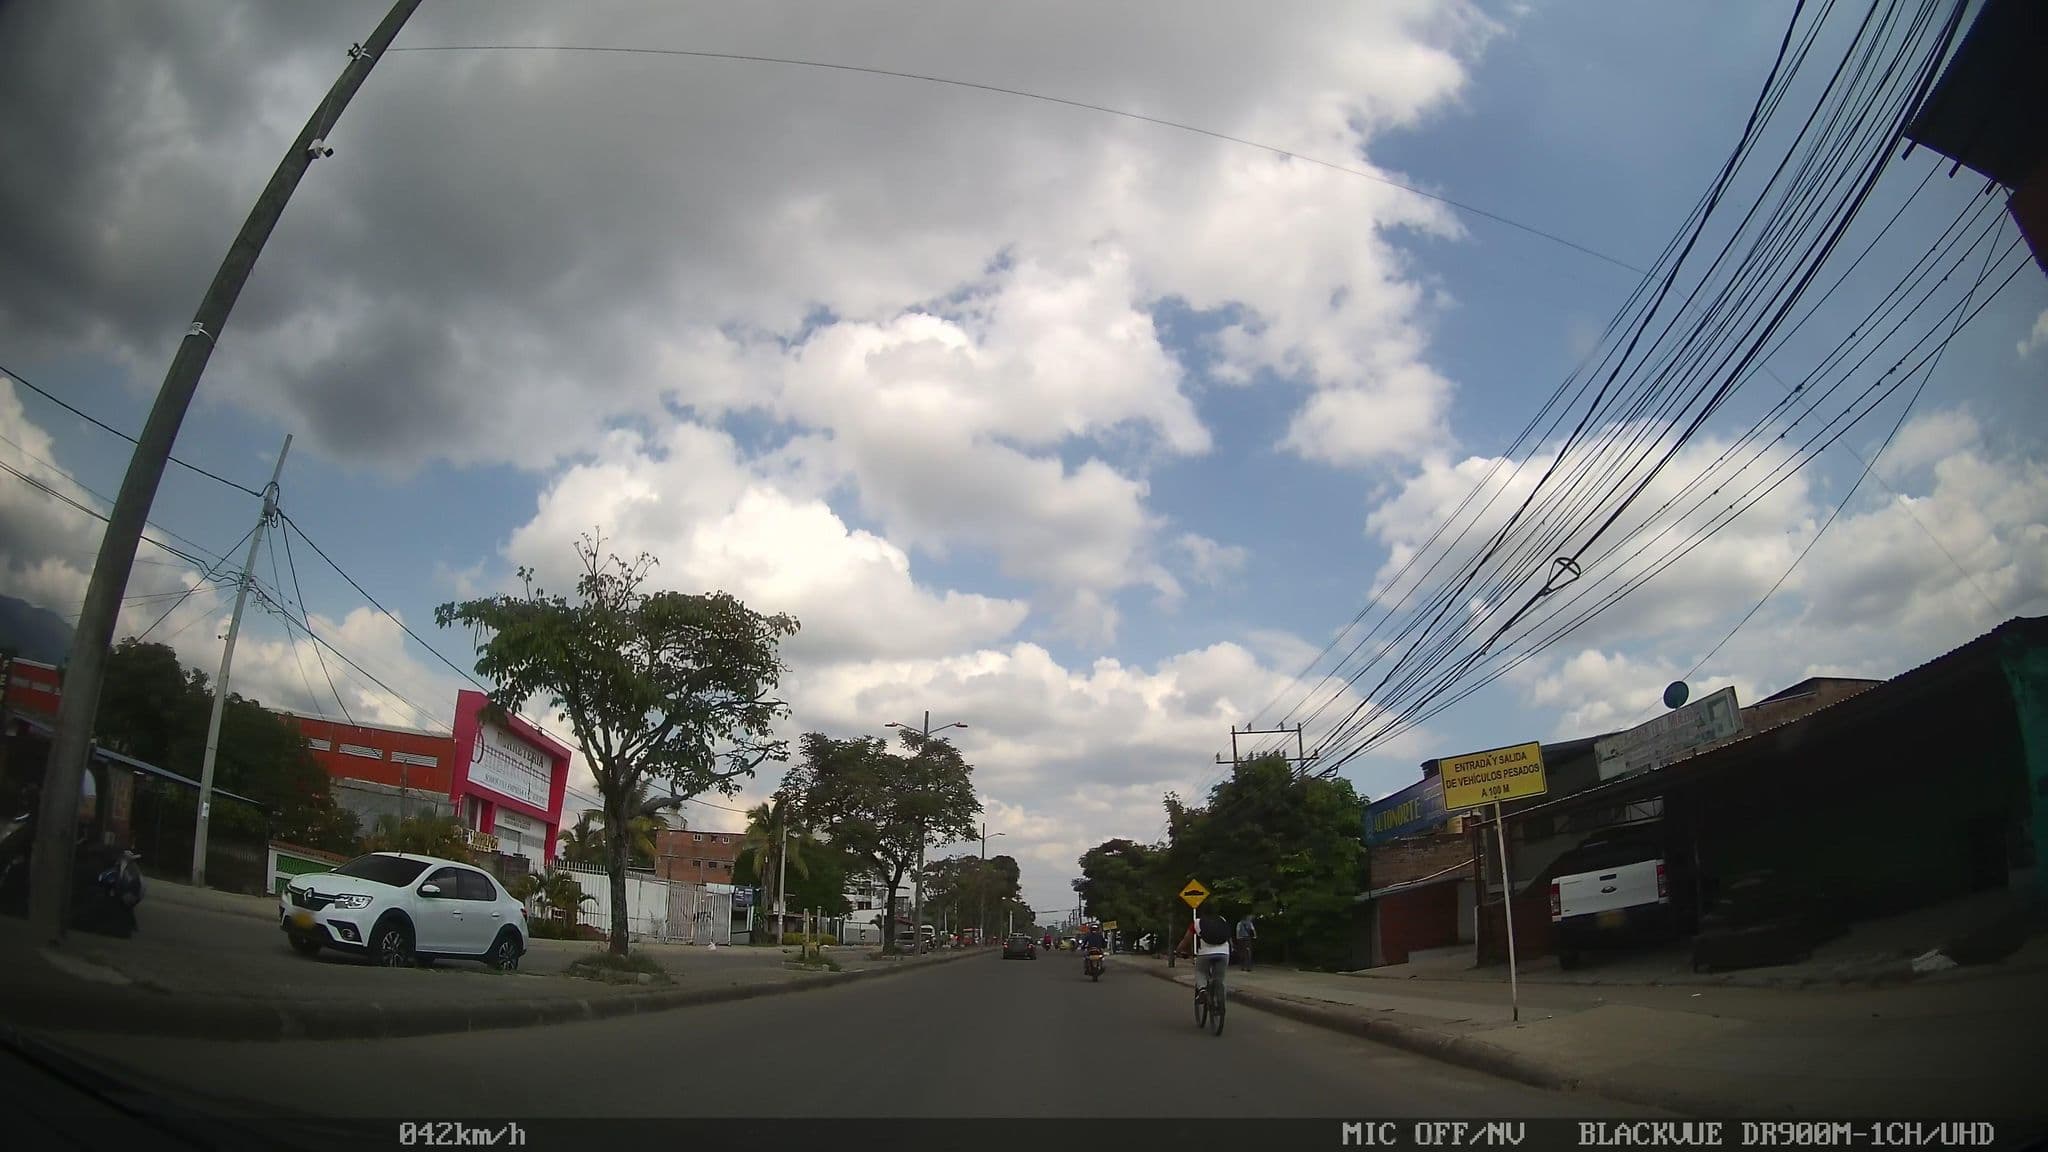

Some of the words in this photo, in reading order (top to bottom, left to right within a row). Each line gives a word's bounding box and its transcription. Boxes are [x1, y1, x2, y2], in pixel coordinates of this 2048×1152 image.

[1455, 758, 1492, 772] ENTRADA
[1492, 757, 1498, 766] Y
[1499, 752, 1527, 765] SALIDA
[1446, 778, 1457, 789] DE
[1503, 763, 1540, 778] PESADOS
[1481, 788, 1488, 798] A
[1489, 785, 1501, 796] 100
[1503, 784, 1510, 793] M
